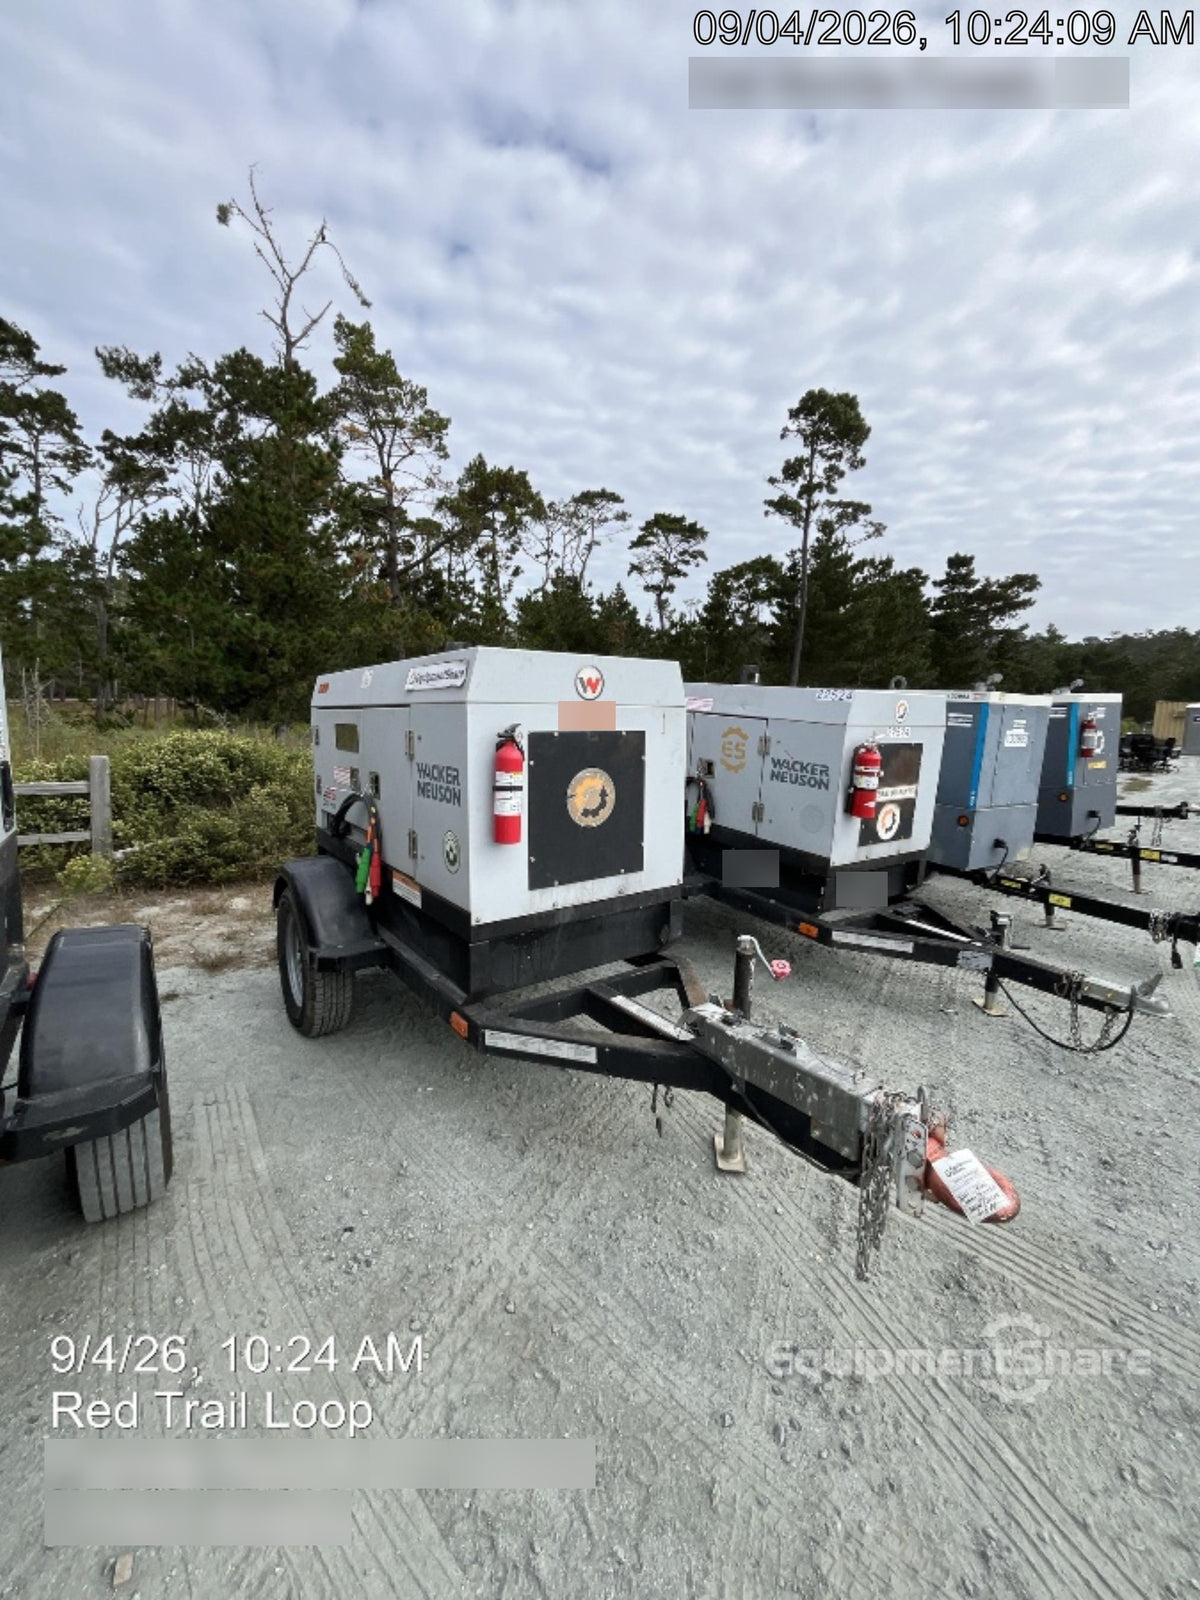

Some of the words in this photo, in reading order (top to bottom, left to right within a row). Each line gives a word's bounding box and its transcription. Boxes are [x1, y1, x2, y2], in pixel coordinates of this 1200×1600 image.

[722, 740, 746, 759] ES
[416, 762, 461, 787] WACKER
[770, 756, 830, 778] WACKER
[770, 770, 830, 790] NEUSON
[416, 780, 461, 808] NEUSON
